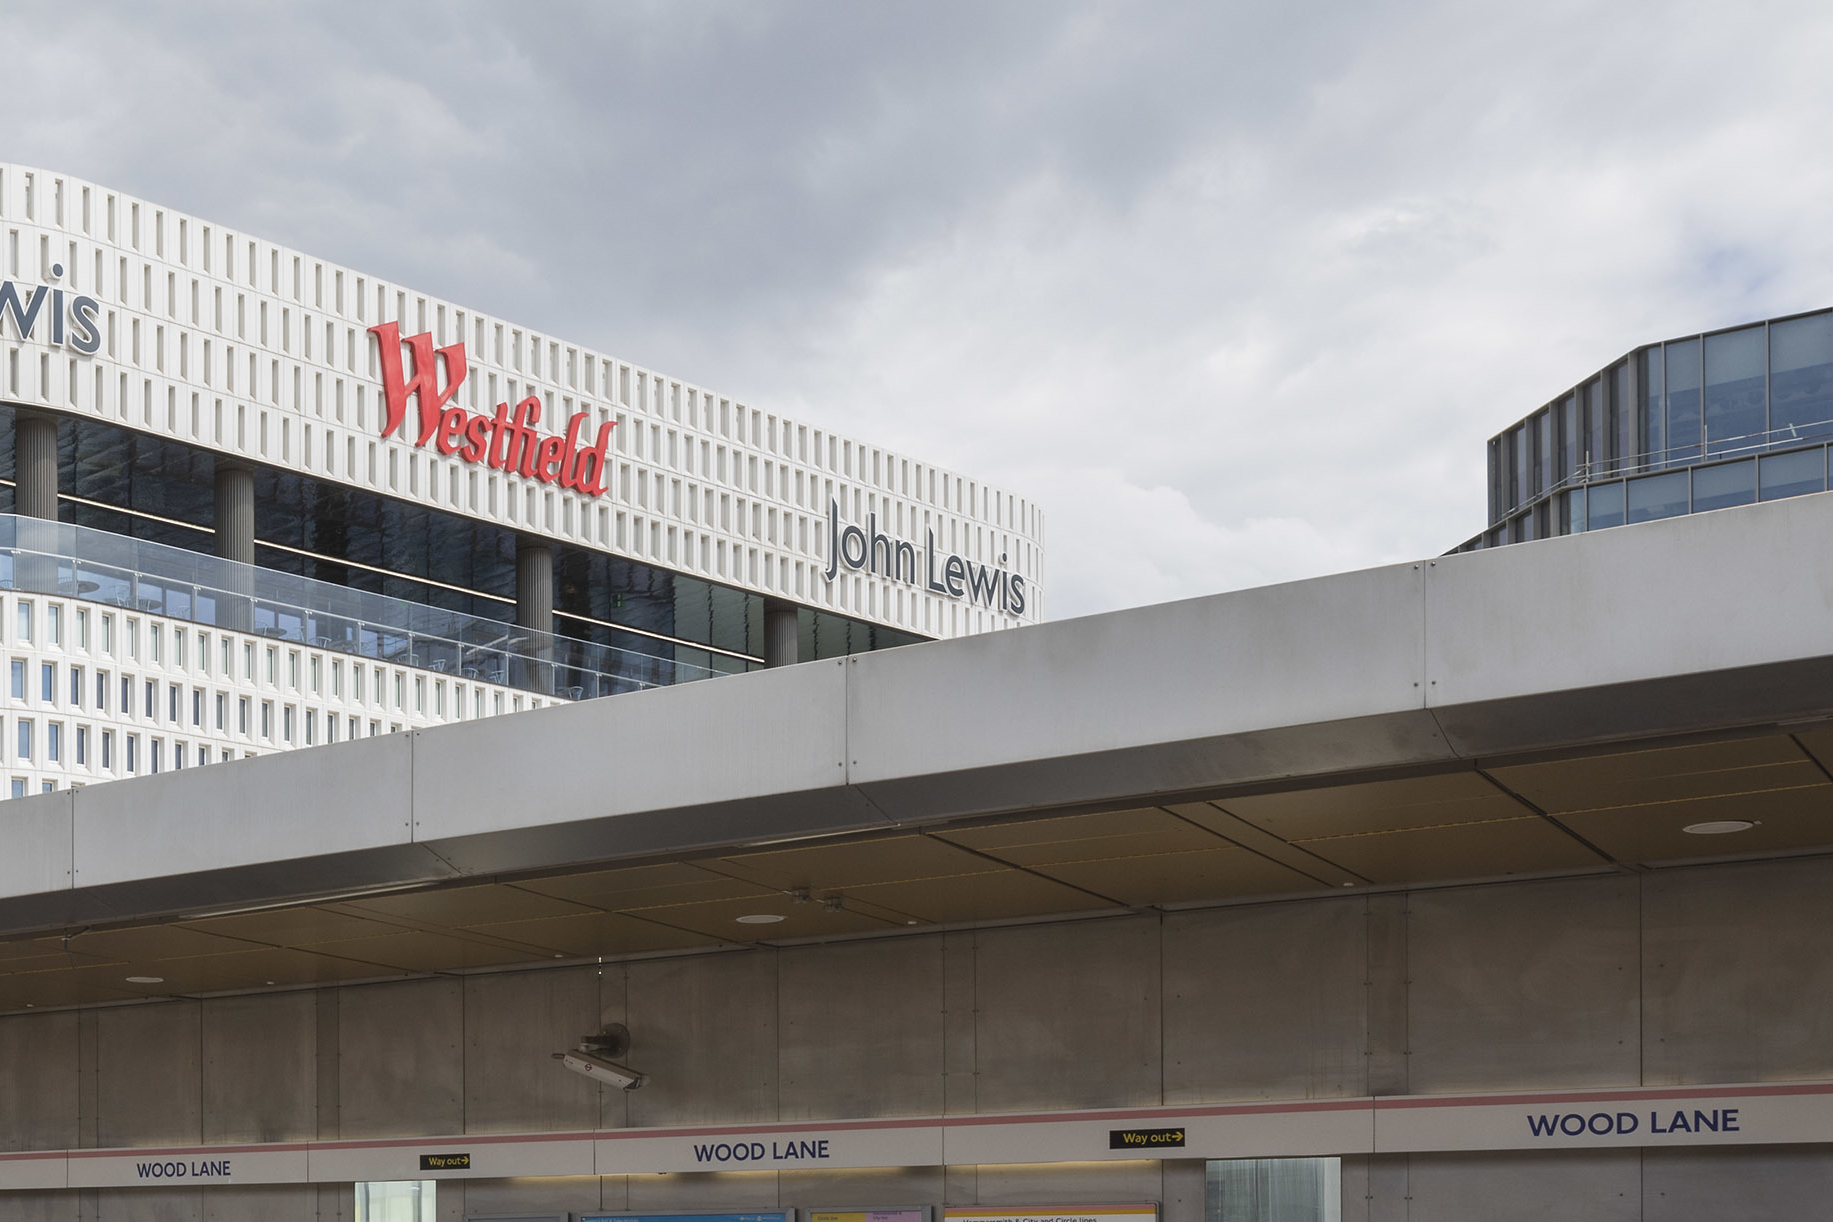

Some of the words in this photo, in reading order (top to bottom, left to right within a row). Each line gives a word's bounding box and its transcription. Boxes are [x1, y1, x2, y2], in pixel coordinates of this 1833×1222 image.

[367, 320, 618, 497] Westfield
[822, 496, 916, 584] John
[928, 526, 1026, 615] Lewis
[1527, 1112, 1639, 1136] WOOD
[1650, 1109, 1740, 1133] LANE
[1123, 1133, 1147, 1144] Way
[1150, 1133, 1171, 1142] out
[429, 1157, 445, 1167] Way
[447, 1157, 460, 1165] out
[694, 1143, 766, 1162] WOOD
[773, 1140, 830, 1159] LANE
[137, 1163, 187, 1178] WOOD
[191, 1161, 231, 1176] LANE
